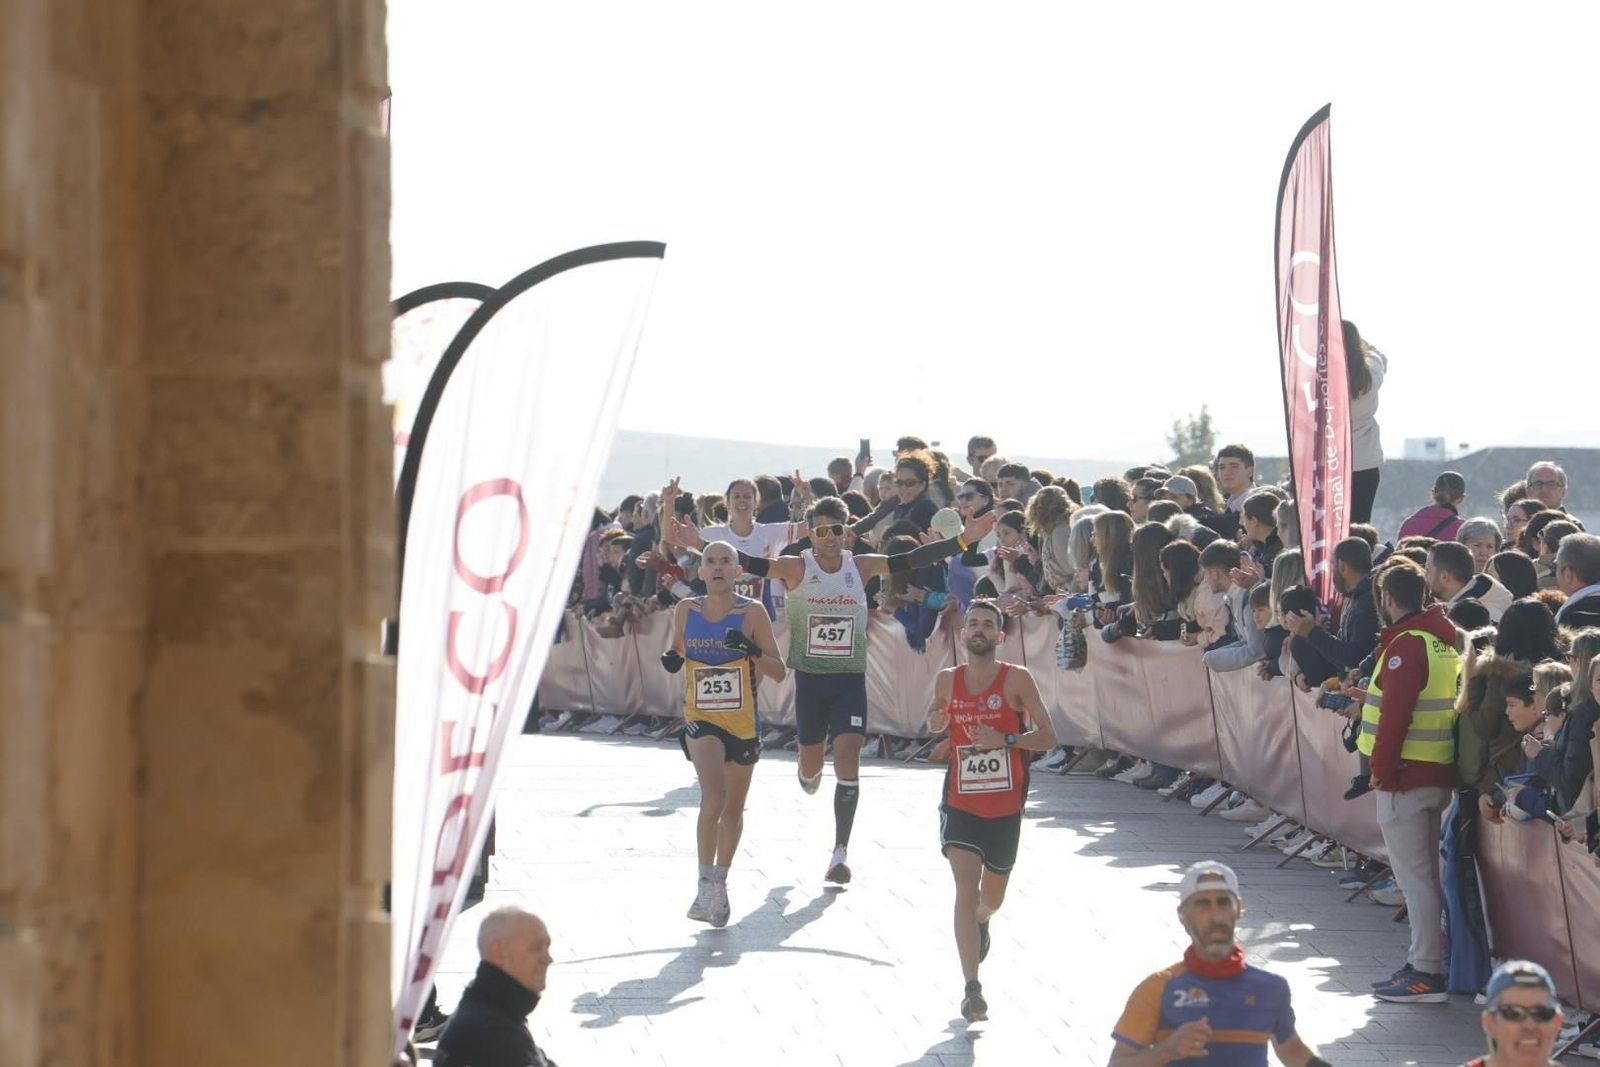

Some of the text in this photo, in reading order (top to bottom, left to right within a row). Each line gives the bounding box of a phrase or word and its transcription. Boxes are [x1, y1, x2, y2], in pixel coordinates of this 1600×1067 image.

[1327, 446, 1339, 471] de
[817, 628, 846, 641] 457
[703, 681, 732, 694] 253
[966, 758, 1001, 774] 460
